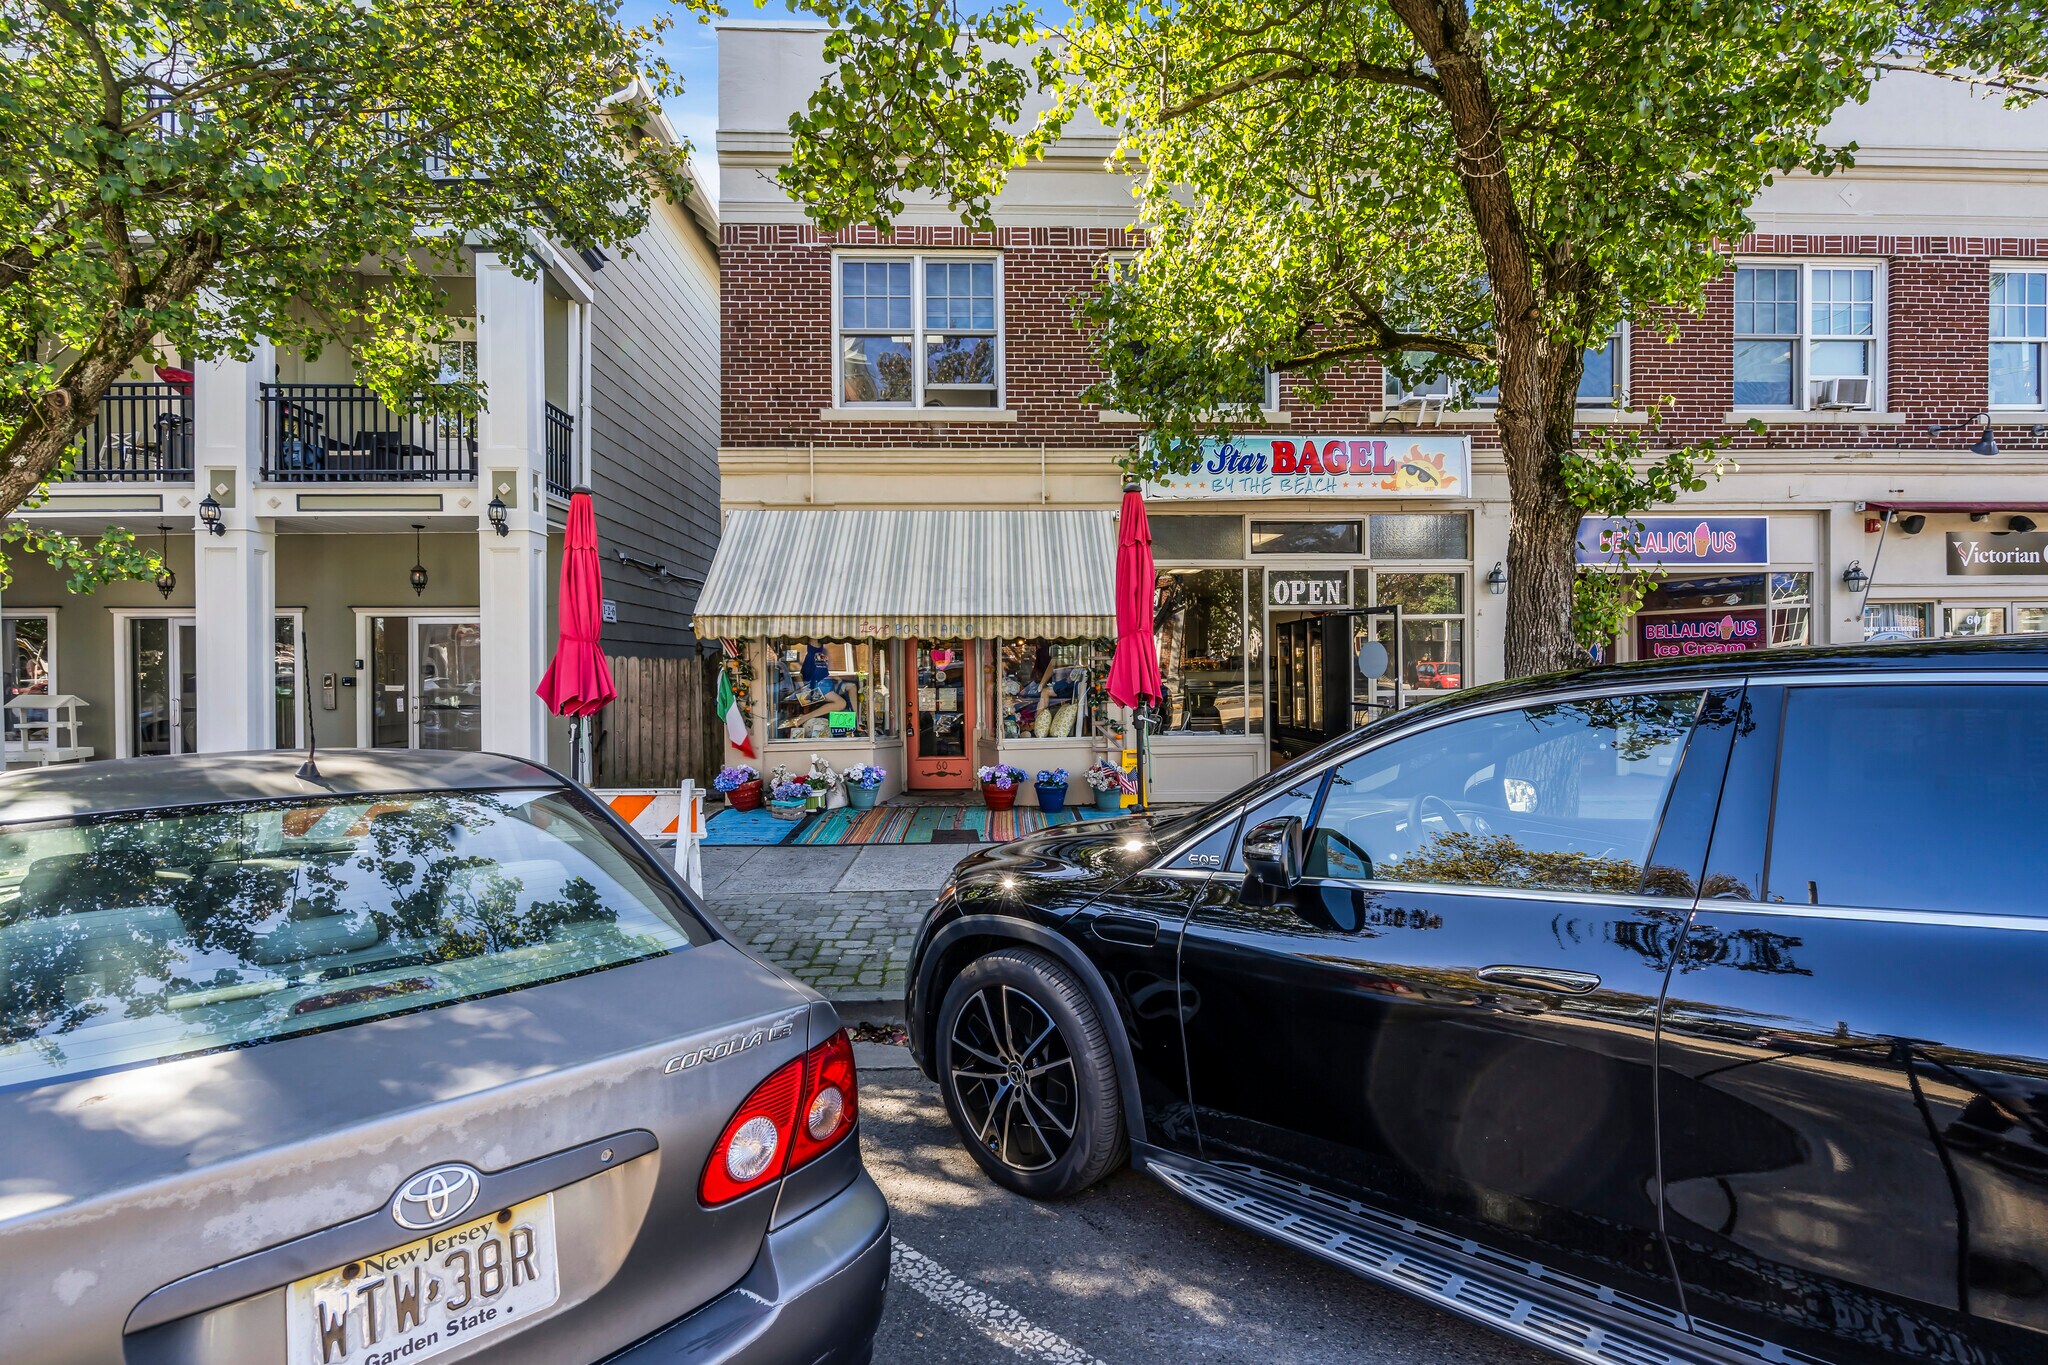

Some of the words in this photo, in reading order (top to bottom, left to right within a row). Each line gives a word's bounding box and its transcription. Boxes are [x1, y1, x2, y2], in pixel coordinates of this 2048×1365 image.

[1207, 444, 1268, 474] Star
[1271, 440, 1396, 475] BAGEL
[1211, 477, 1234, 493] BY
[1238, 476, 1274, 495] THE
[1280, 476, 1337, 494] BEACH
[1953, 541, 2041, 567] Victorian
[1274, 580, 1341, 604] OPEN
[860, 621, 890, 637] Love
[895, 623, 974, 635] POSITANO
[1966, 615, 1981, 625] 60
[1654, 643, 1679, 656] Ice
[1683, 641, 1746, 656] Cream
[936, 761, 948, 771] 60
[1188, 854, 1221, 865] EQS
[664, 1031, 764, 1074] COROLLA
[363, 1248, 421, 1279] New
[424, 1222, 493, 1262] Jersey
[365, 1332, 438, 1365] Garden
[446, 1308, 497, 1337] State
